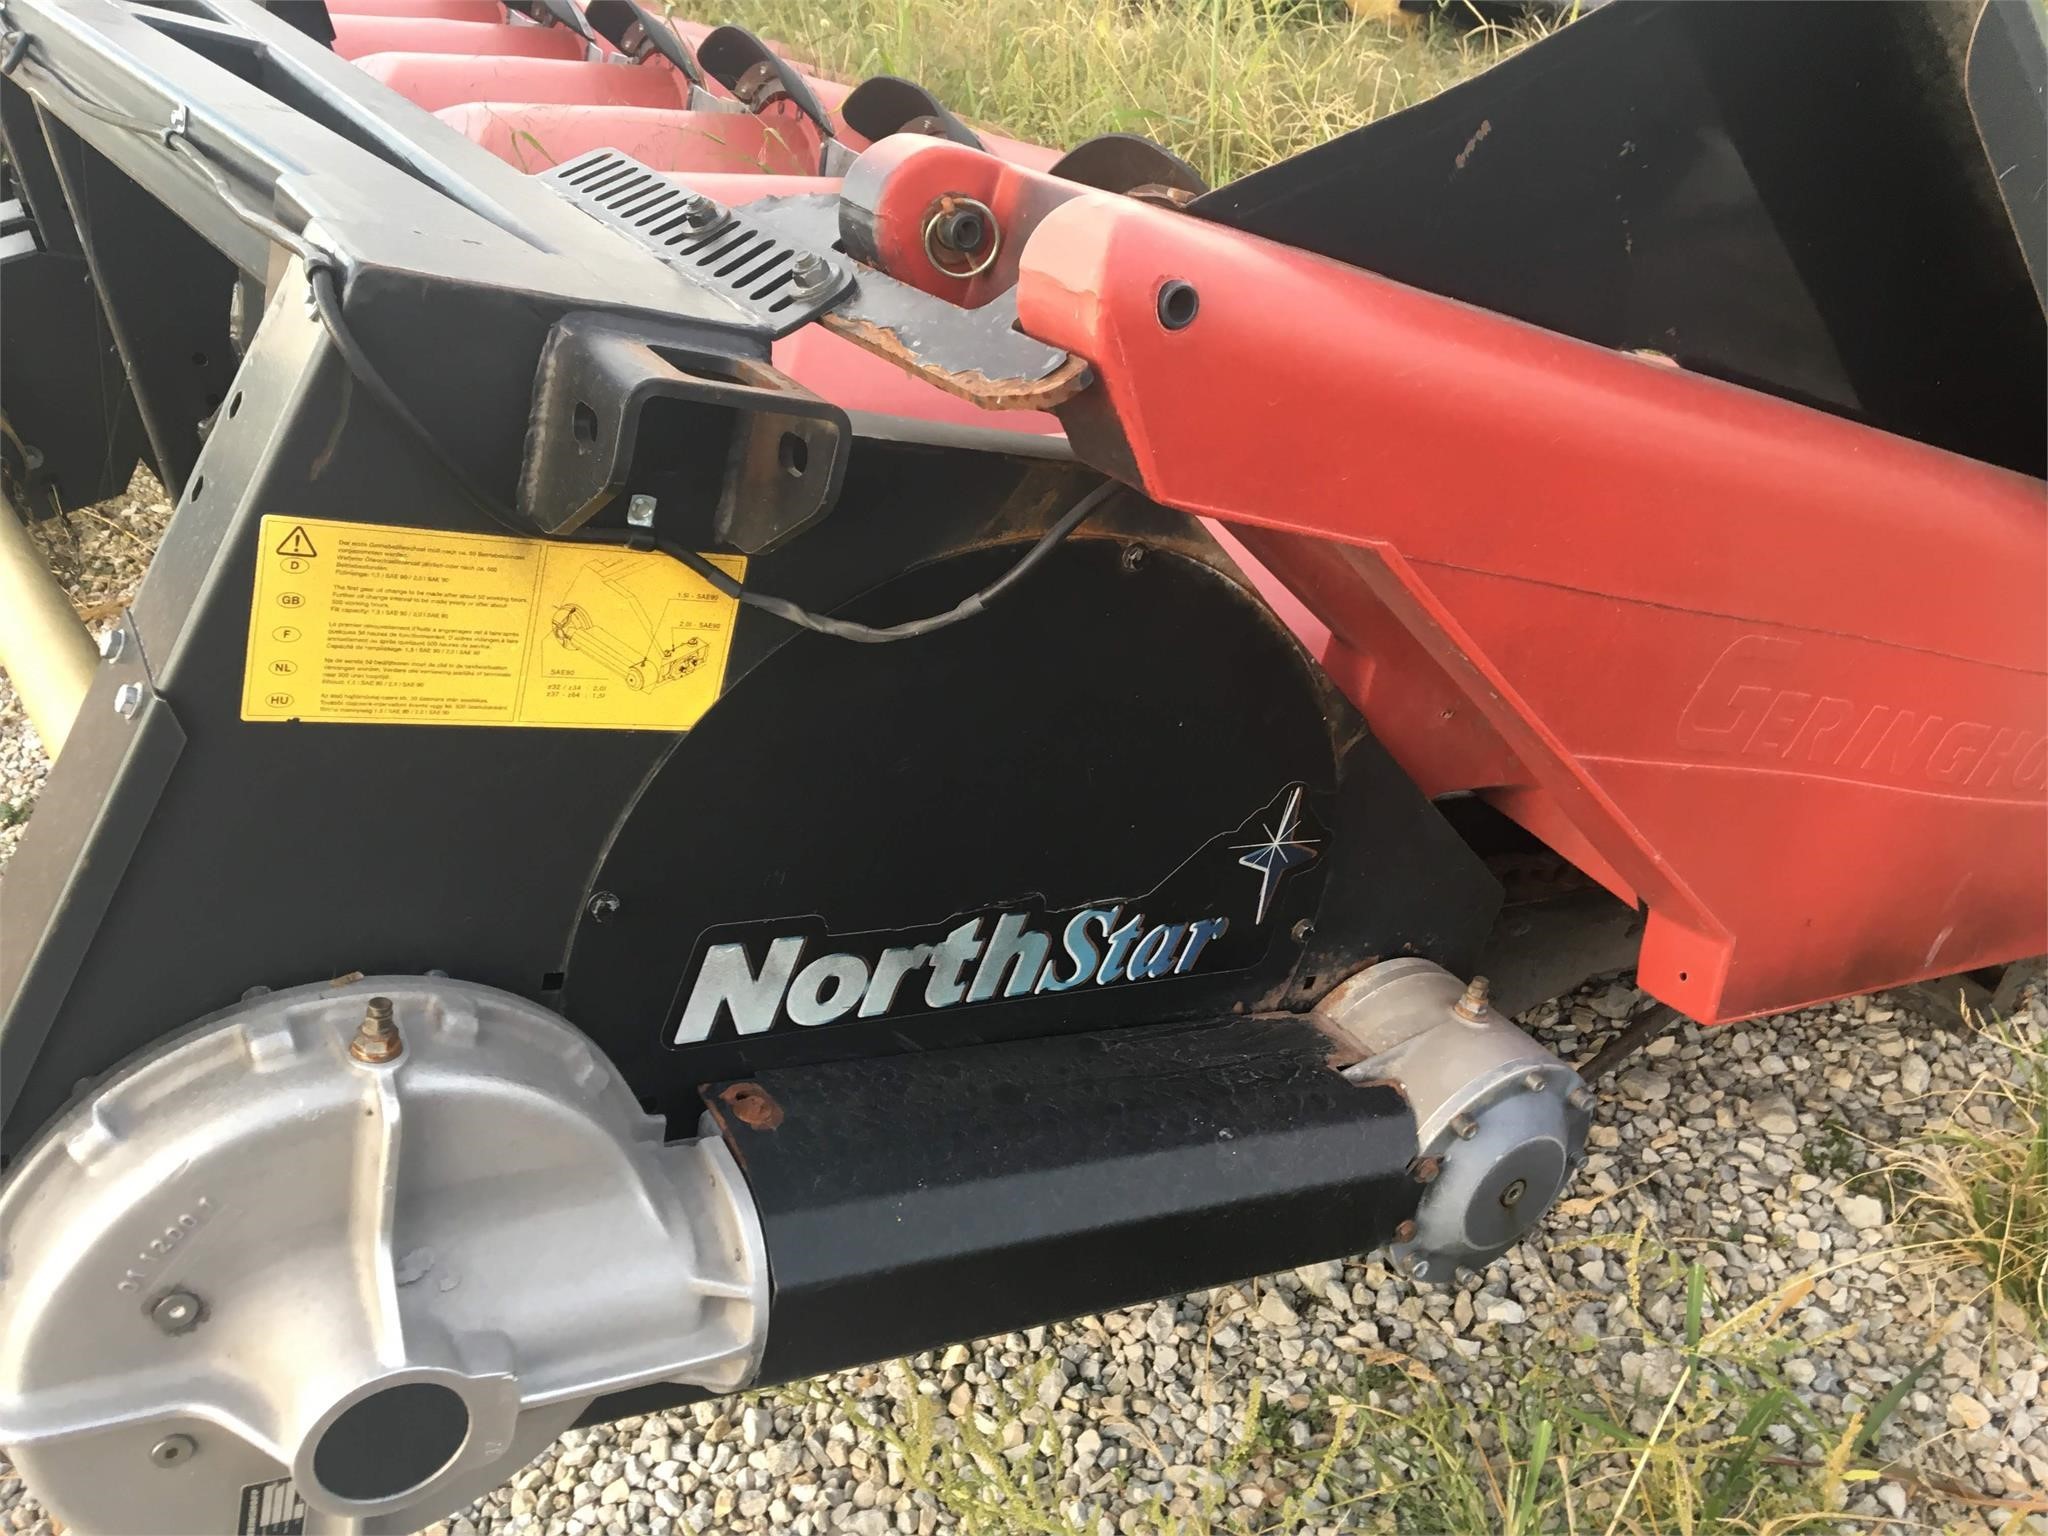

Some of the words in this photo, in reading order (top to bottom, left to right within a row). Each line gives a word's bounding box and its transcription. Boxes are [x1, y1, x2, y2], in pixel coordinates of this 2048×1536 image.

[290, 561, 300, 569] D
[282, 595, 300, 605] GB
[283, 630, 291, 638] F
[275, 663, 292, 672] NL
[270, 696, 289, 705] HU
[1676, 634, 2048, 790] GERINGHO
[674, 905, 1229, 1045] NorthStar
